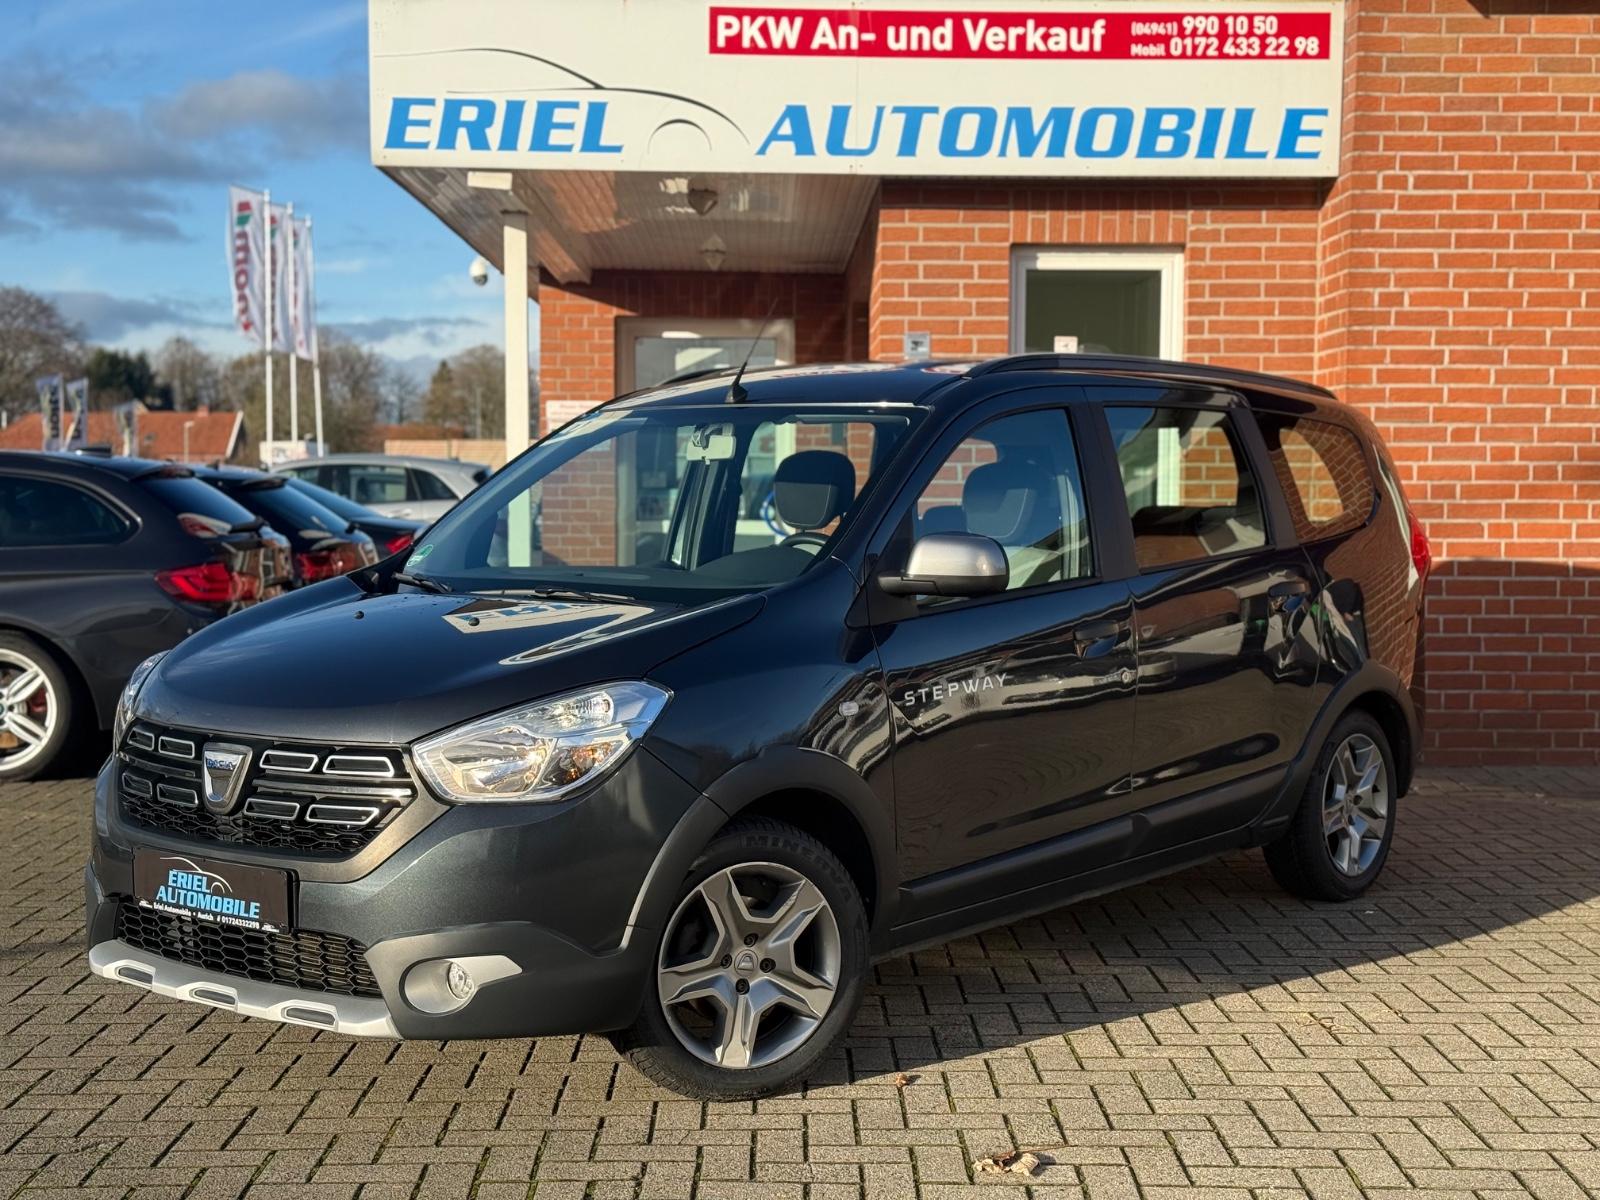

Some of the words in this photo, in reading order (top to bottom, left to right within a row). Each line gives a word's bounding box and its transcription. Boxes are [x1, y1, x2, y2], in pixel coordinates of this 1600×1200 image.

[716, 15, 802, 50] PKW
[810, 16, 876, 50] An-
[887, 18, 953, 52] und
[962, 19, 1106, 53] Verkauf
[1182, 15, 1220, 36] 990
[1224, 15, 1249, 36] 10
[1253, 15, 1279, 36] 50
[1130, 43, 1166, 57] Mobil
[1169, 36, 1219, 57] 0172
[1222, 36, 1261, 57] 433
[1264, 36, 1290, 57] 22
[1294, 36, 1320, 57] 98
[383, 97, 624, 154] ERIEL
[755, 104, 1329, 160] AUTOMOBILE
[903, 672, 1008, 706] STEPWAY
[168, 869, 211, 894] ERIEL
[156, 885, 261, 919] AUTOMOBILE
